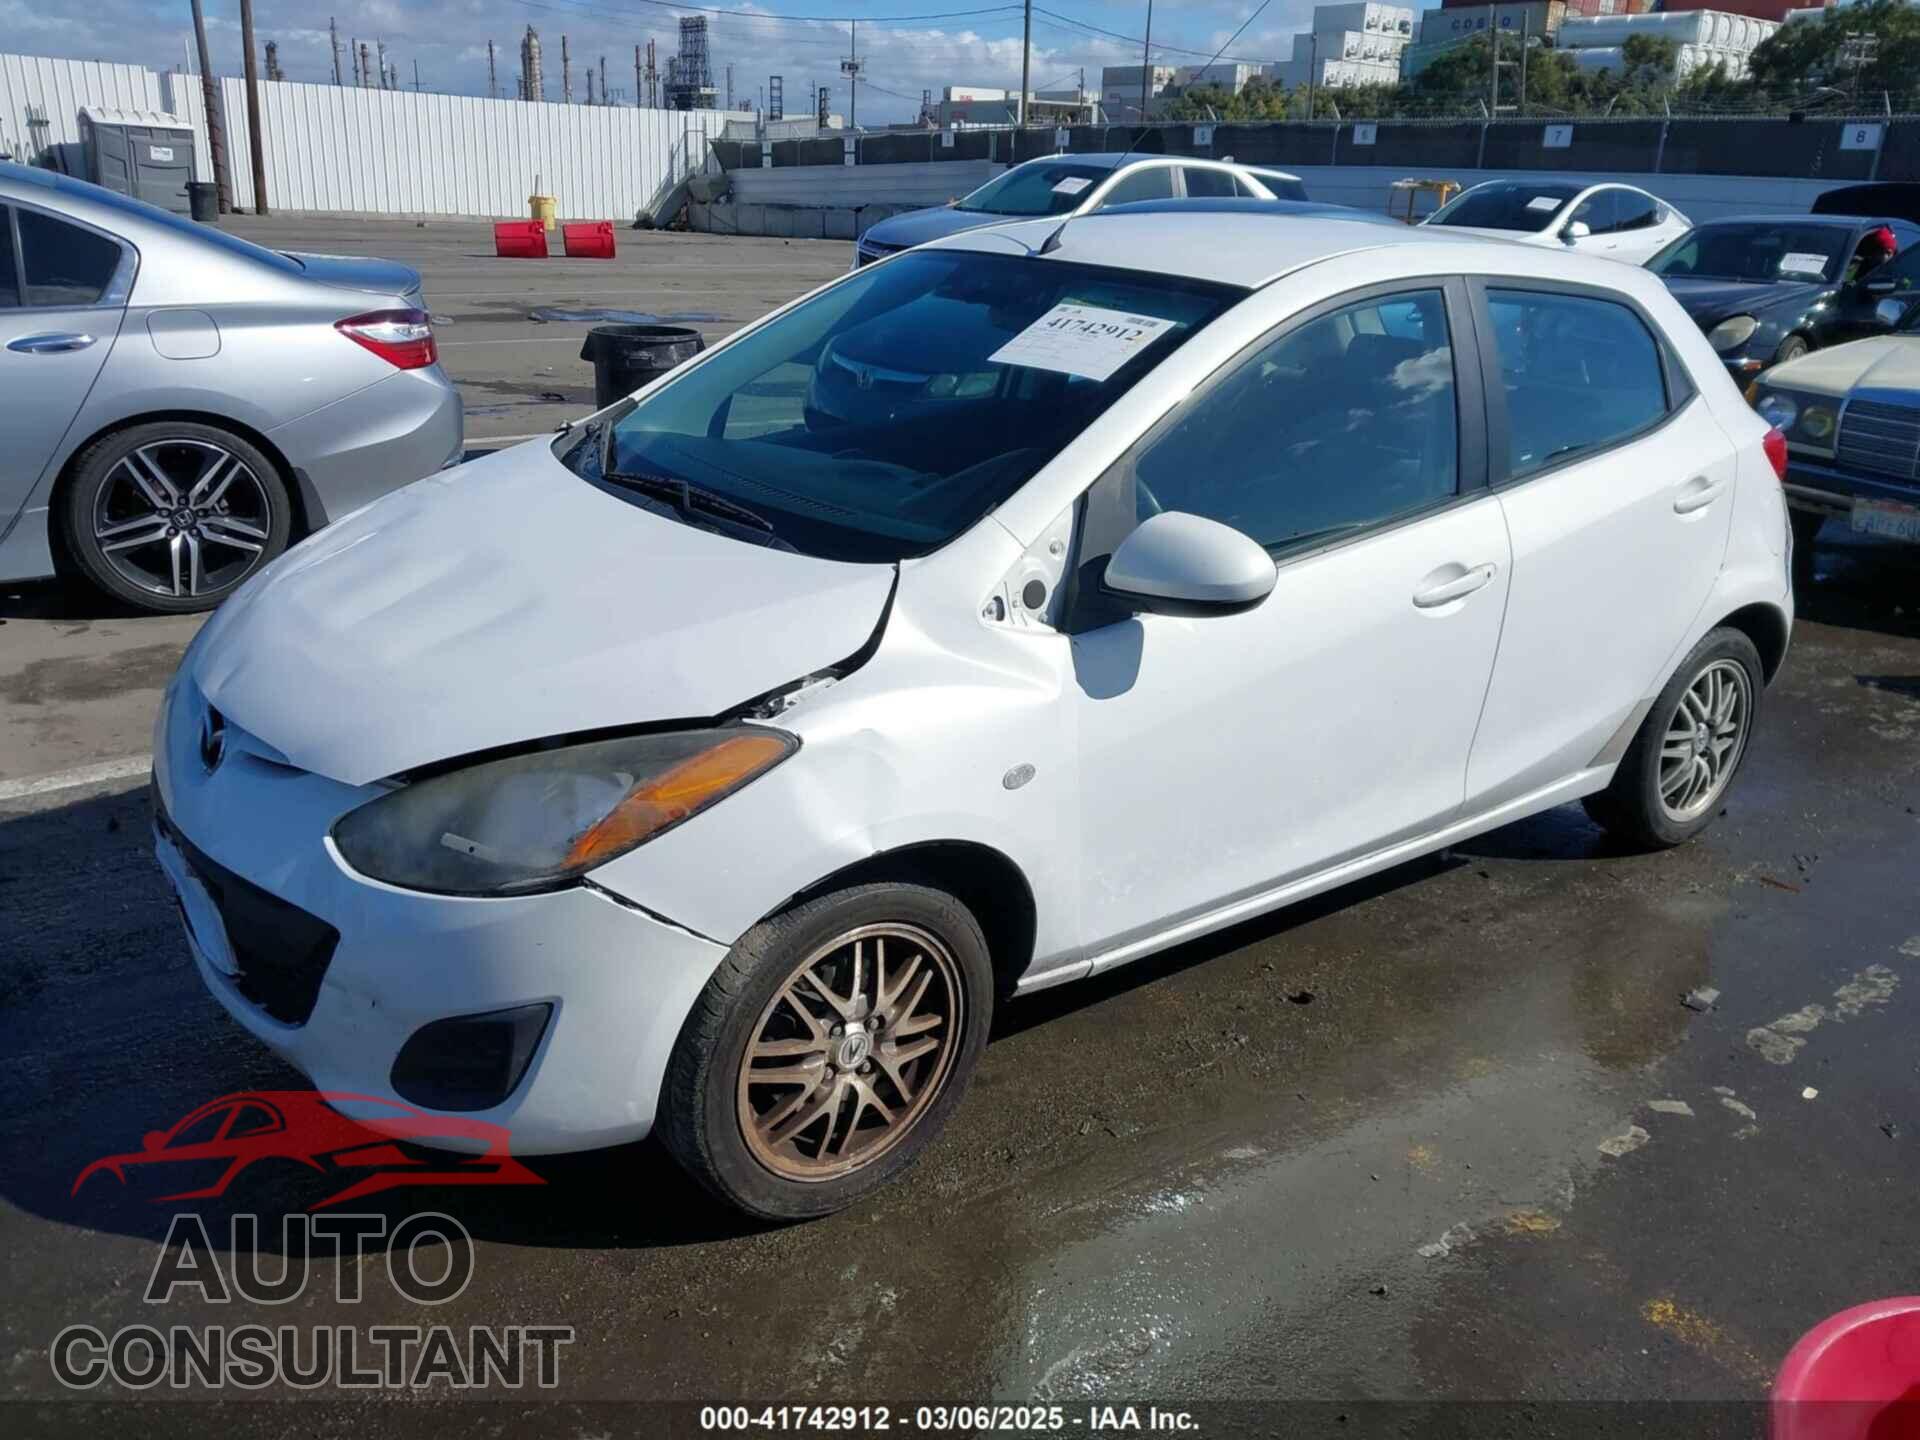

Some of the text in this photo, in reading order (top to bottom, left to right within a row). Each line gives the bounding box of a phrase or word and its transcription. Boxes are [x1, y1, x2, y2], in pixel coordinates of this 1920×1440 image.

[1451, 16, 1511, 30] COSO
[1856, 130, 1866, 143] 8
[1047, 317, 1143, 341] 41742912
